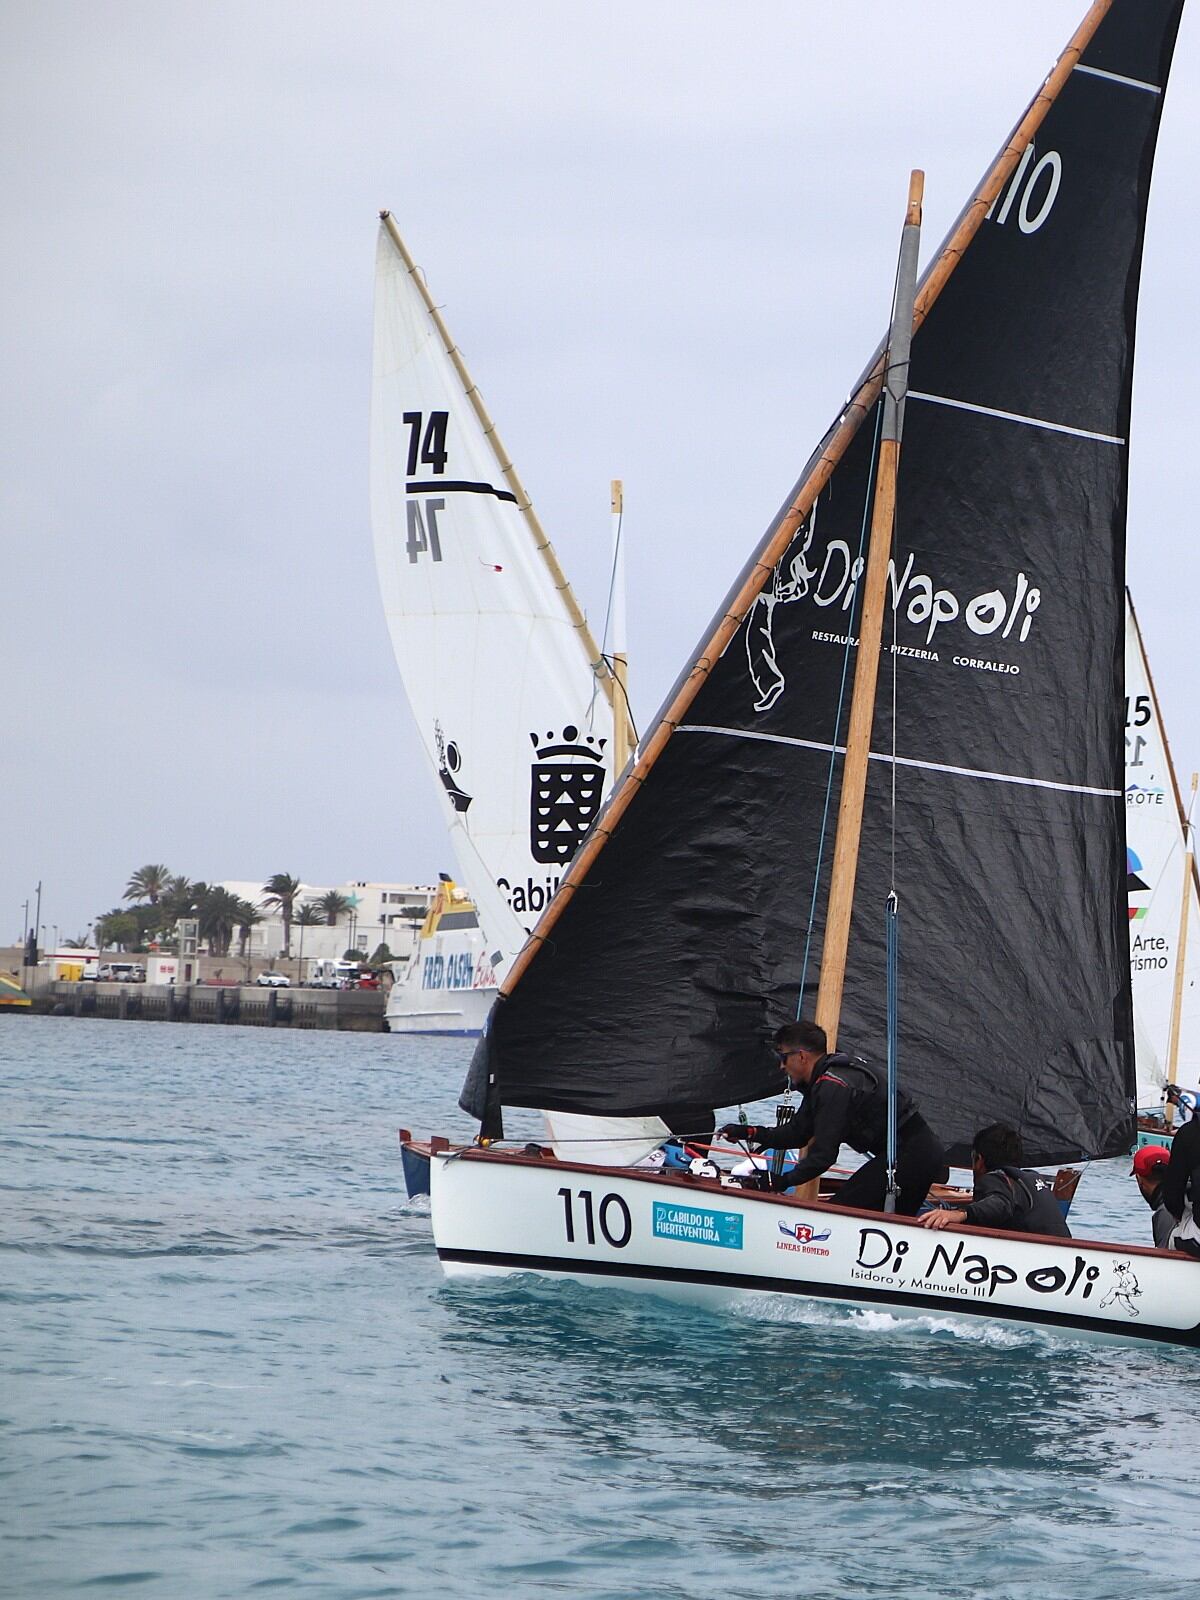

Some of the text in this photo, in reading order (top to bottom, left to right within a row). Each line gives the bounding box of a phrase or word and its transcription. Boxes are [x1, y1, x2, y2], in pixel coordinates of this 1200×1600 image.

[402, 411, 449, 476] 74
[813, 540, 864, 611] Di
[886, 552, 1041, 646] Napoli
[811, 630, 883, 652] RESTAURA
[890, 644, 940, 662] PIZZERIA
[952, 655, 1020, 676] CORRALEJO
[446, 952, 474, 990] OLSEN
[557, 1187, 633, 1249] 110
[656, 1221, 720, 1242] FUERTEVENTURA
[667, 1210, 702, 1227] CABILDO
[704, 1216, 715, 1229] DE
[776, 1241, 830, 1257] LINEAS ROMERO
[856, 1228, 1100, 1298] Di Napoli
[851, 1268, 986, 1297] Isidoro y Manuela III
